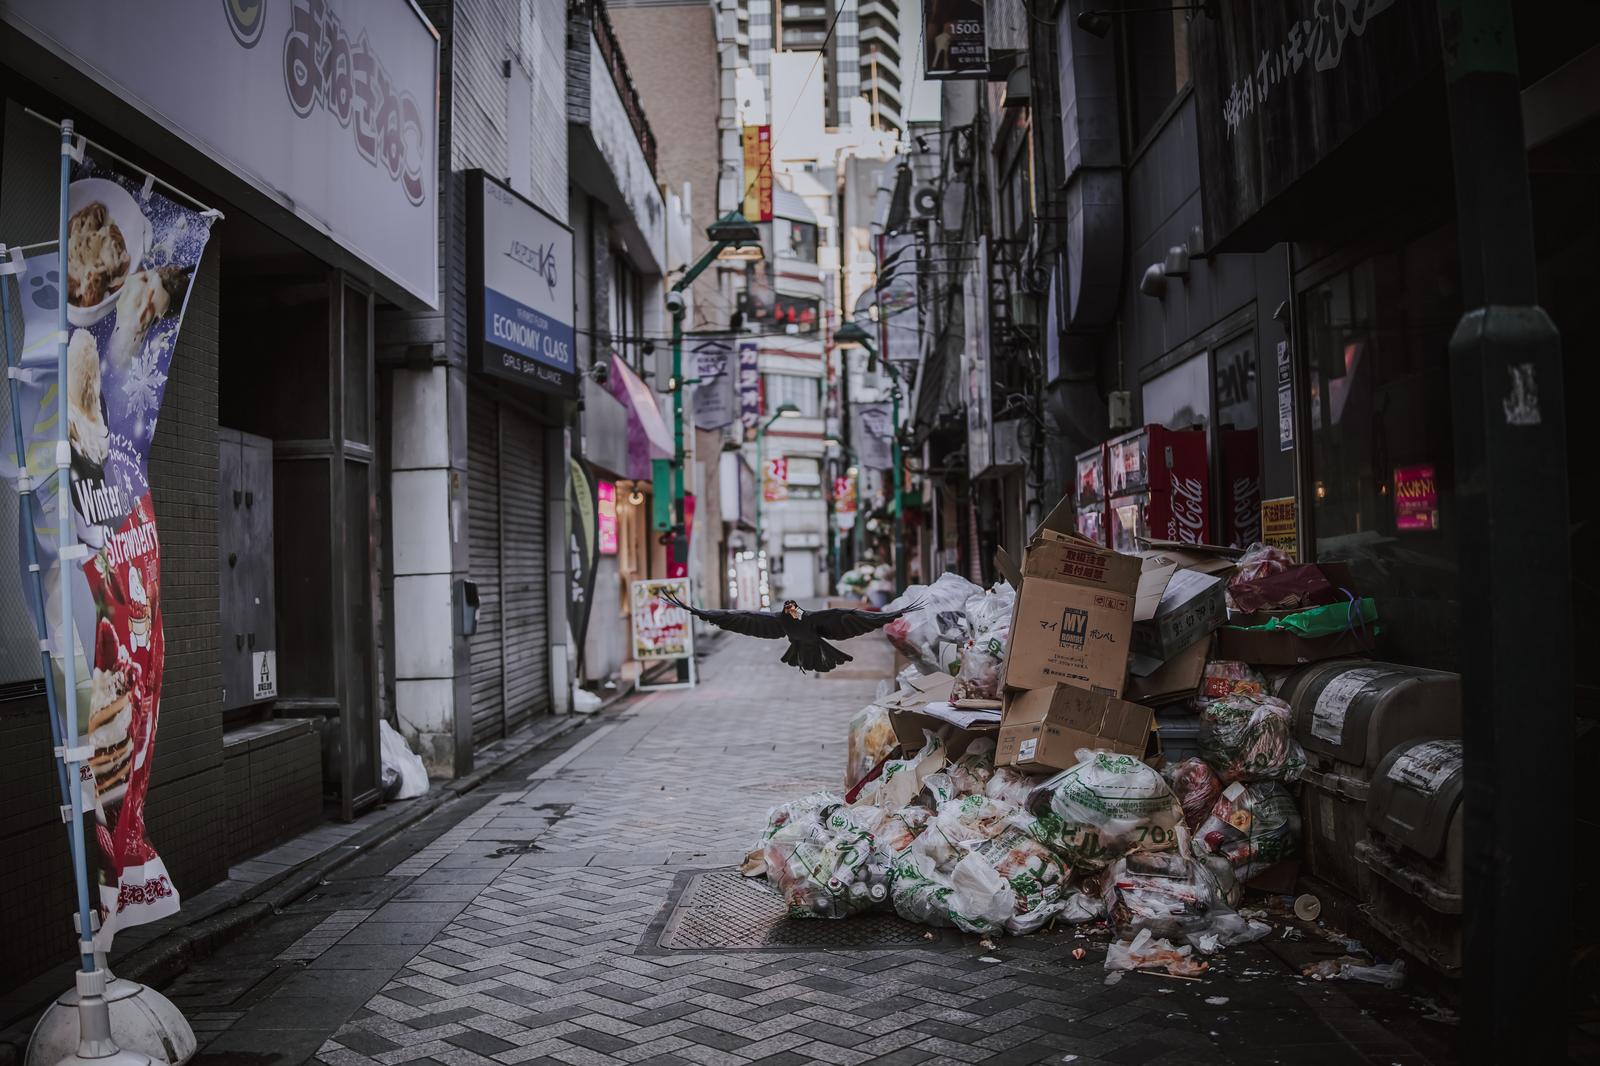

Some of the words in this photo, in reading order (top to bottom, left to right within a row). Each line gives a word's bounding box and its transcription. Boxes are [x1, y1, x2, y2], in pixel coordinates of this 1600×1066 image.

[950, 23, 980, 34] 1500
[283, 0, 425, 207] まねきねこ
[494, 313, 540, 352] ECONOMY
[543, 335, 569, 364] CLASS
[503, 353, 521, 371] GIRLS
[523, 360, 536, 374] BAR
[537, 366, 562, 386] ALLIANCE
[75, 478, 123, 526] Winter
[103, 518, 159, 566] Strawberry
[1040, 620, 1058, 631] マイ
[1062, 612, 1088, 635] MY
